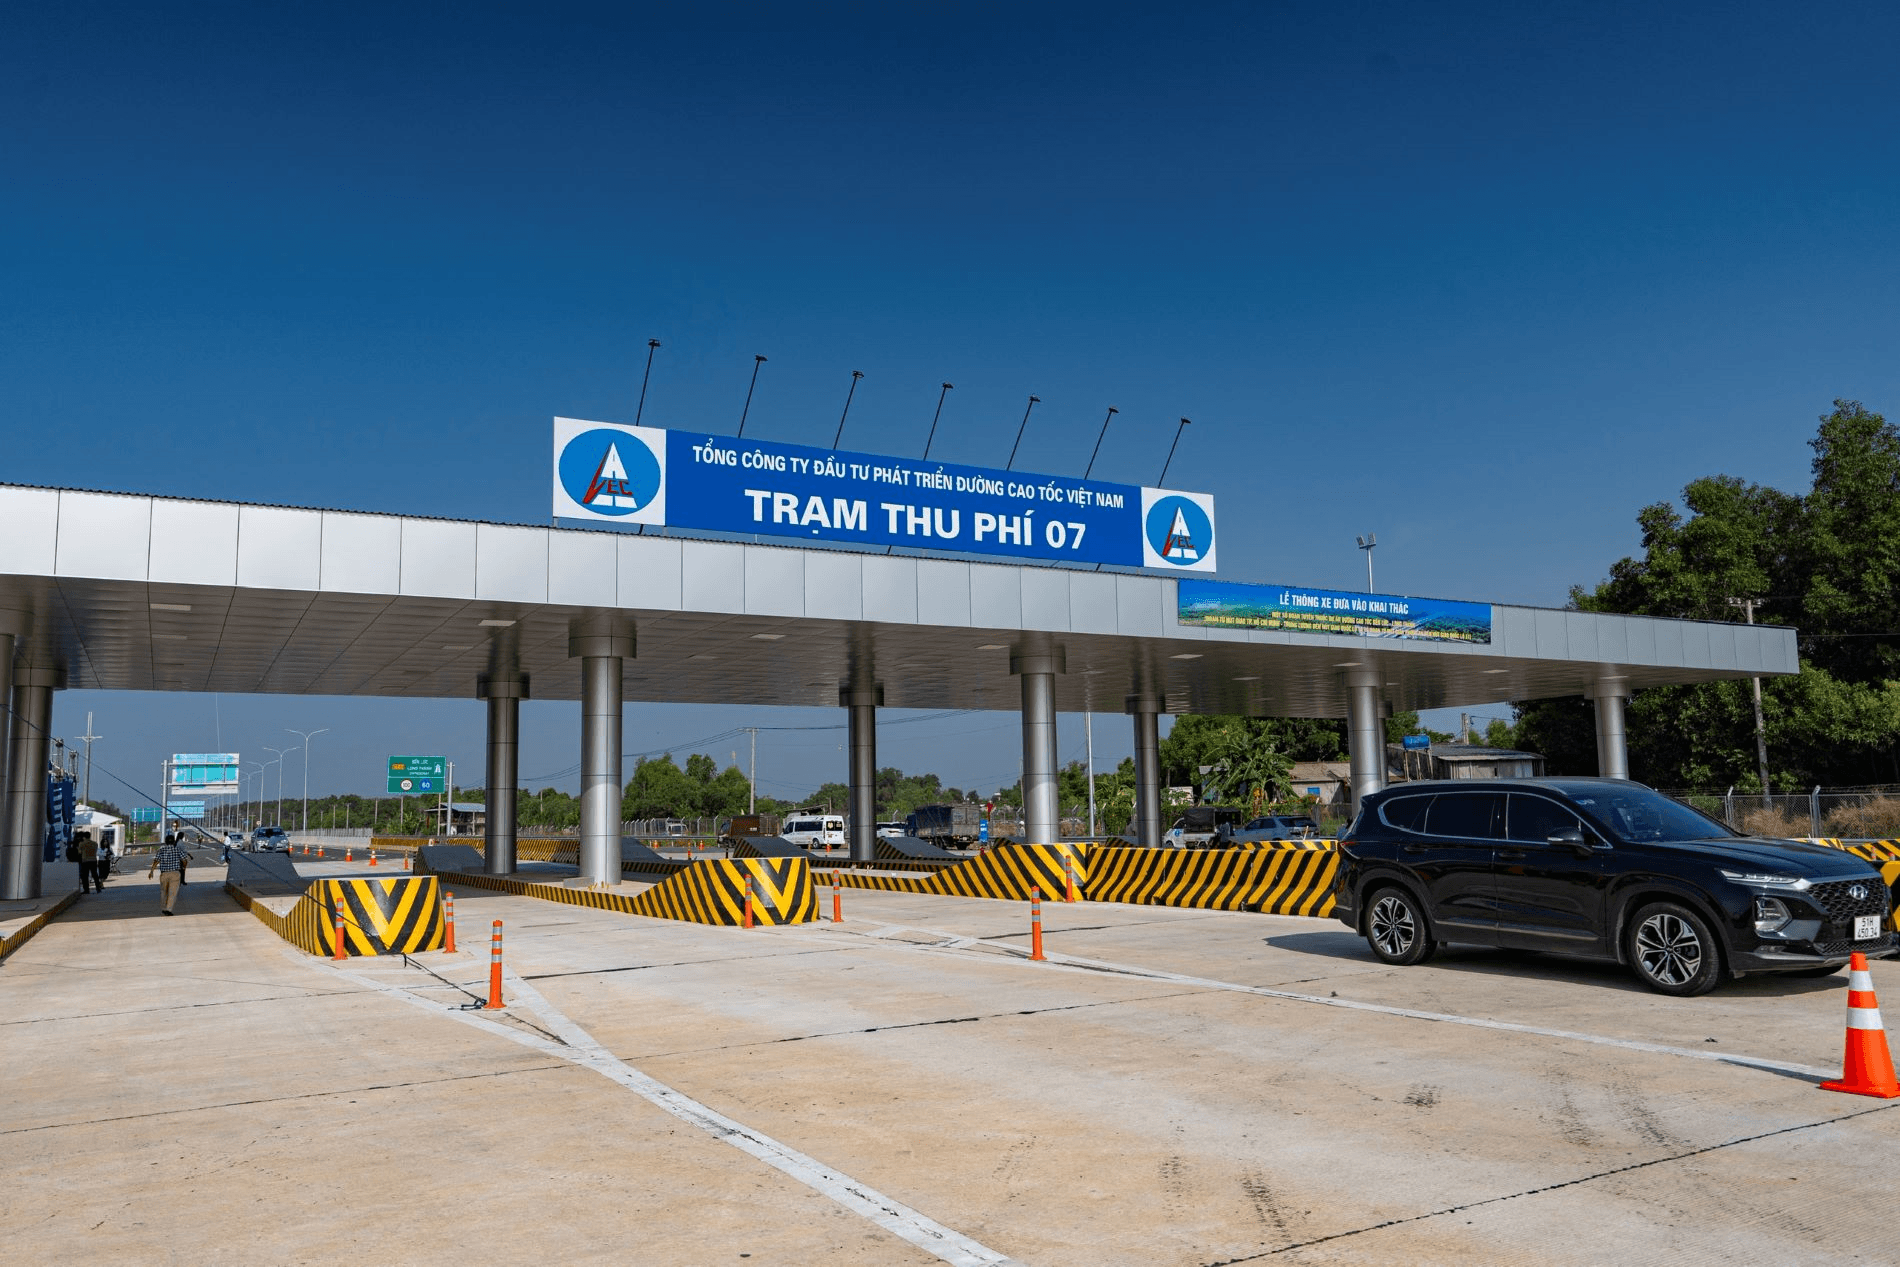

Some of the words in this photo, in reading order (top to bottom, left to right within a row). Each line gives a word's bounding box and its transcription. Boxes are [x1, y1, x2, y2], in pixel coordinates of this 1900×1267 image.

[693, 438, 736, 466] TỔNG
[742, 448, 785, 471] CÔNG
[789, 457, 809, 473] TY
[813, 456, 845, 477] ĐẦU
[850, 464, 870, 480] TƯ
[873, 465, 910, 486] PHÁT
[914, 466, 953, 490] TRIỂN
[956, 474, 1004, 496] ĐƯỜNG
[1007, 482, 1035, 499] CAO
[1038, 481, 1063, 502] TỐC
[1066, 487, 1092, 508] VIỆT
[1096, 493, 1124, 508] NAM
[745, 489, 867, 533] TRẠM
[881, 503, 960, 539] THU
[974, 510, 1033, 546] PHÍ
[1046, 521, 1086, 549] 07
[1280, 591, 1289, 606] LỄ
[1291, 594, 1319, 608] THÔNG
[1321, 597, 1331, 609] XE
[1333, 598, 1350, 610] ĐƯA
[1351, 599, 1367, 612] VÀO
[1368, 602, 1387, 613] KHAI
[1389, 602, 1409, 615] THÁC
